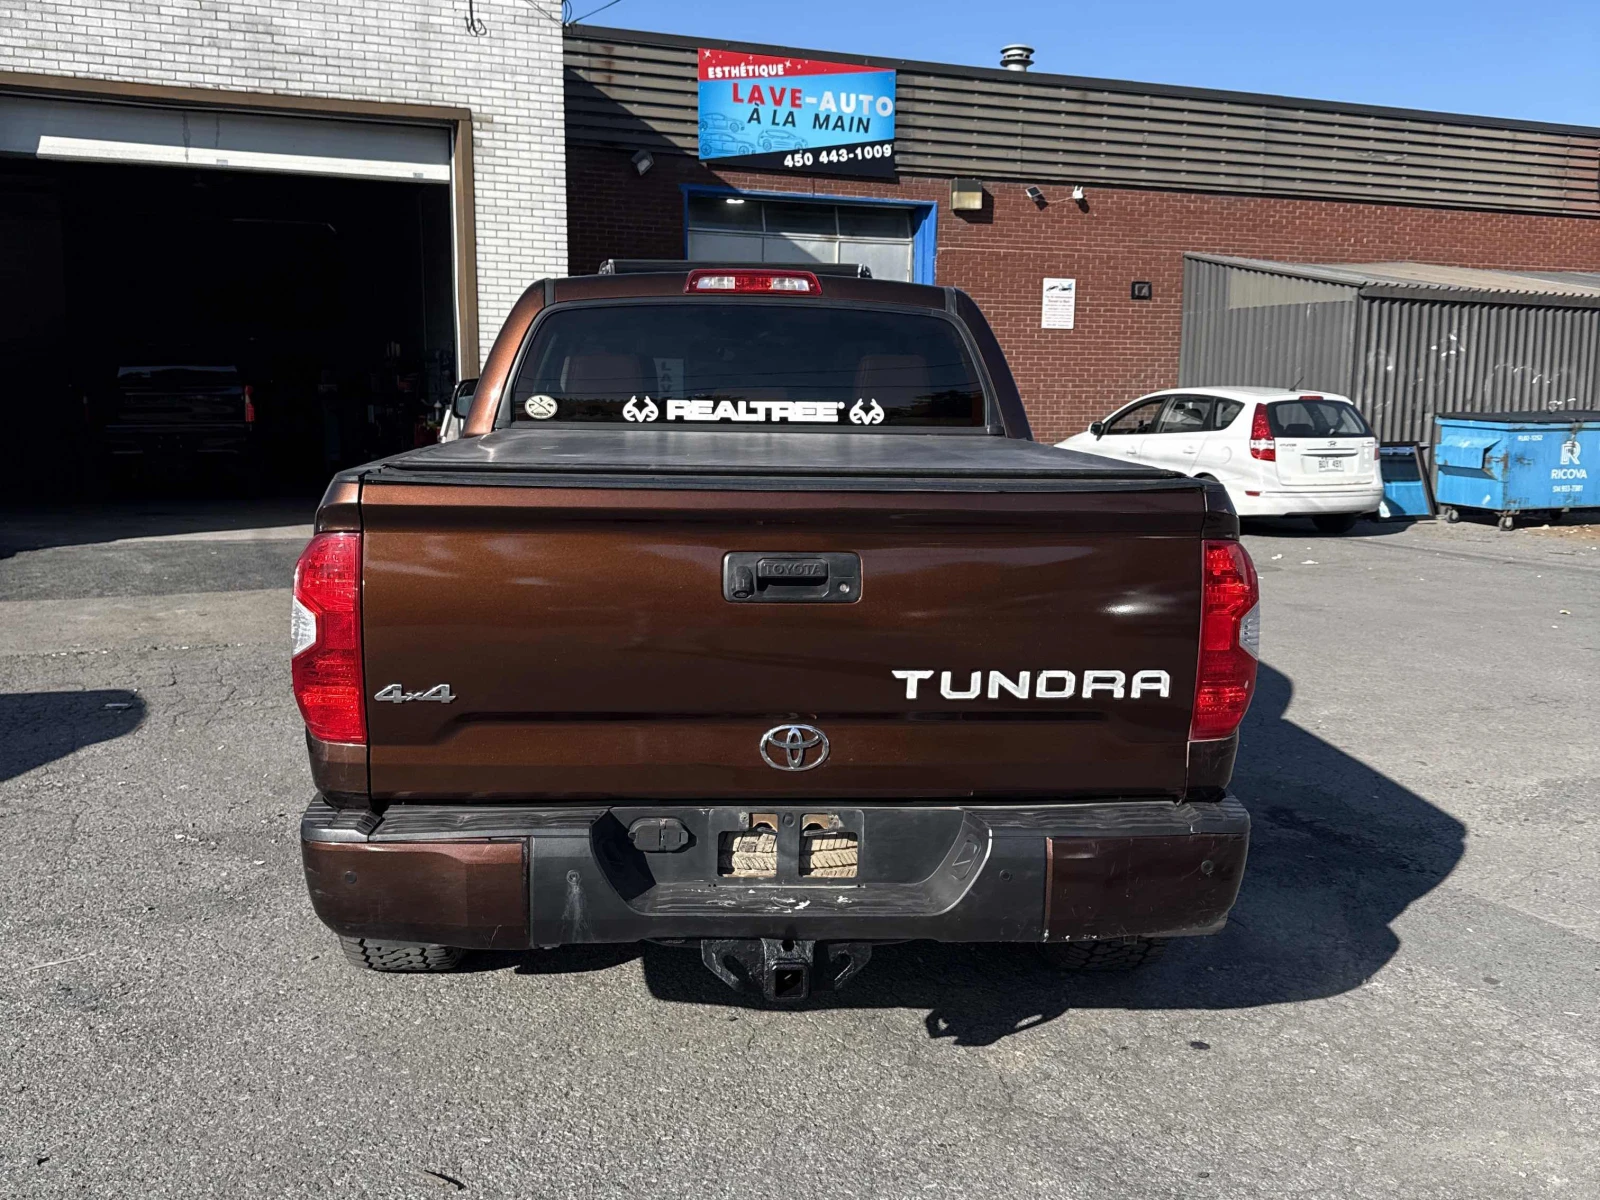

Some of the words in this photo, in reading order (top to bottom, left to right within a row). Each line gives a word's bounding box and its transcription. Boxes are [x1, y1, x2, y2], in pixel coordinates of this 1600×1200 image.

[707, 62, 785, 79] ESTHÉTIQUE
[732, 82, 894, 118] LAVE-AUTO
[747, 103, 762, 125] À
[771, 109, 797, 128] LA
[812, 113, 871, 134] MAIN
[783, 151, 814, 168] 450
[818, 144, 893, 165] 443-1009
[1550, 468, 1588, 480] RICOVA
[764, 563, 821, 575] TOYOTA
[374, 683, 457, 704] 4x4
[891, 670, 1171, 699] TUNDRA
